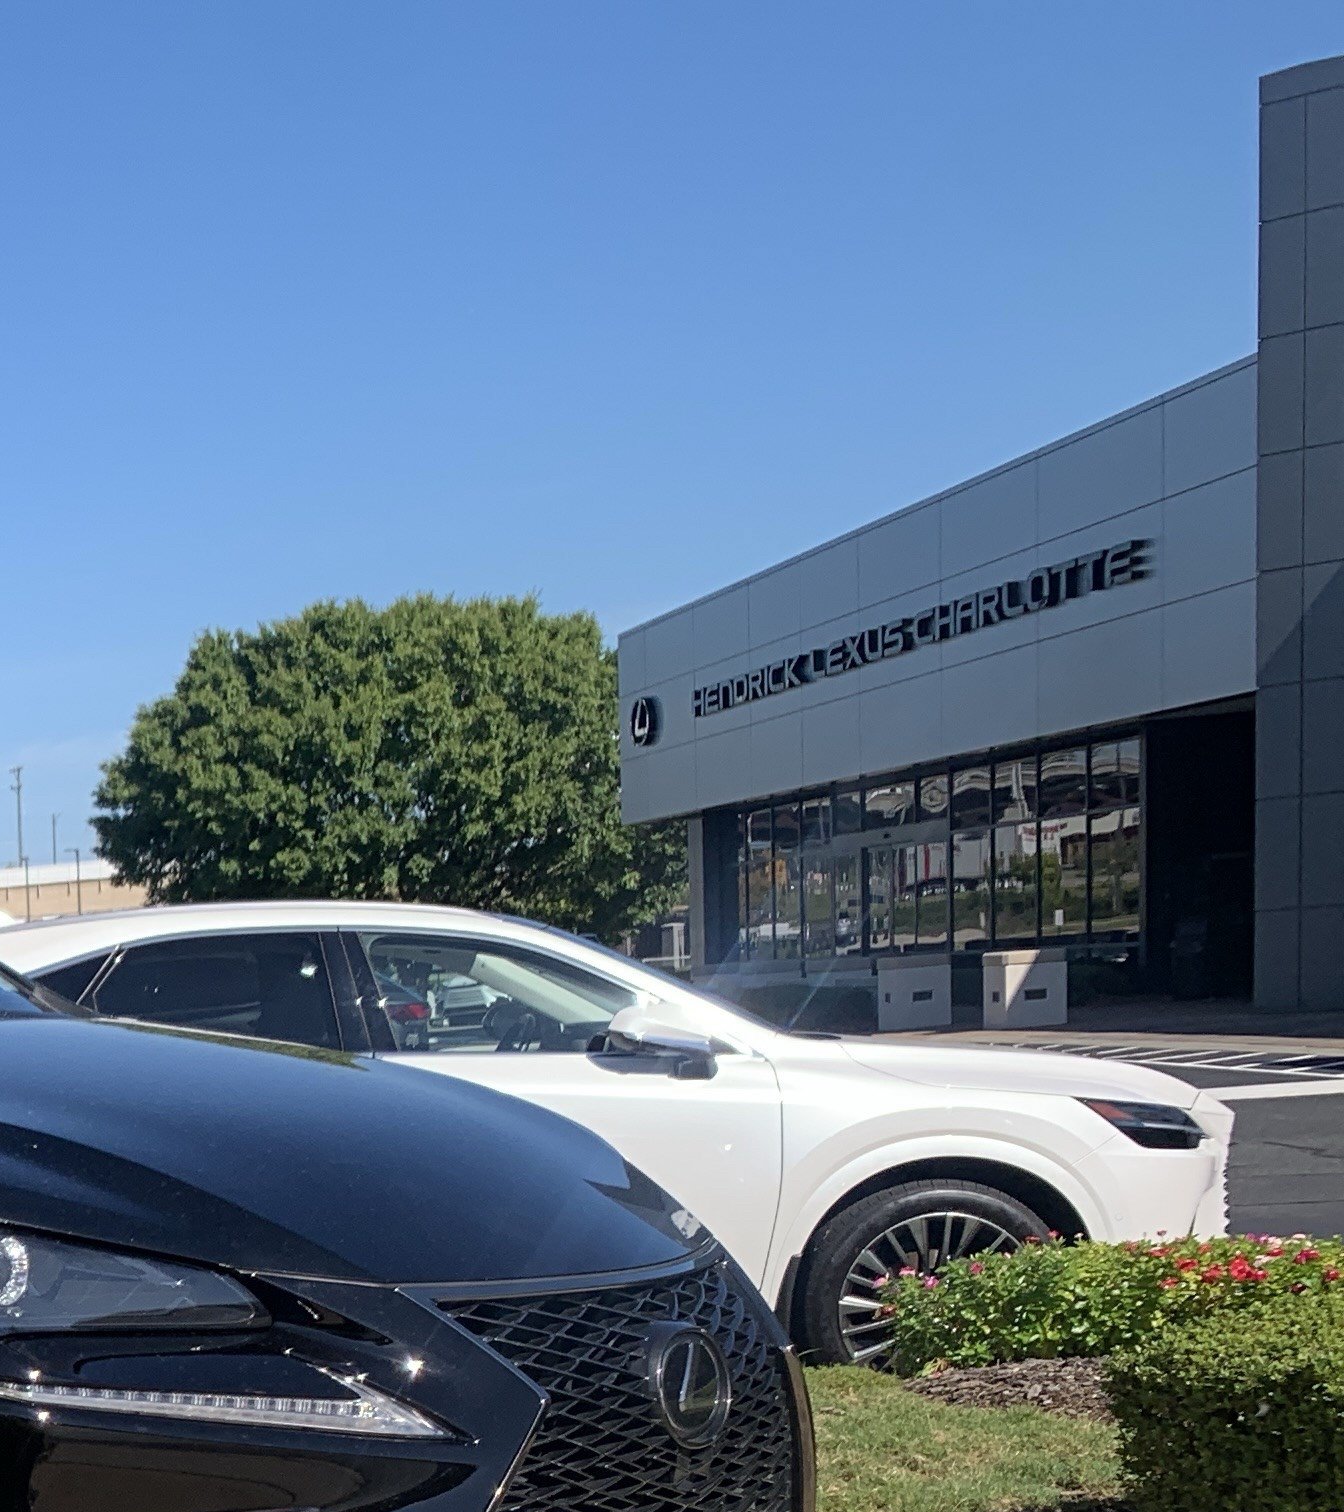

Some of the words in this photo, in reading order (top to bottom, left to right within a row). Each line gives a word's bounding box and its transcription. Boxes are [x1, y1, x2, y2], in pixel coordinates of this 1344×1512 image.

[691, 654, 806, 718] HENDRICK
[809, 617, 910, 680] LEXUS
[912, 538, 1157, 647] CHARLOTTE
